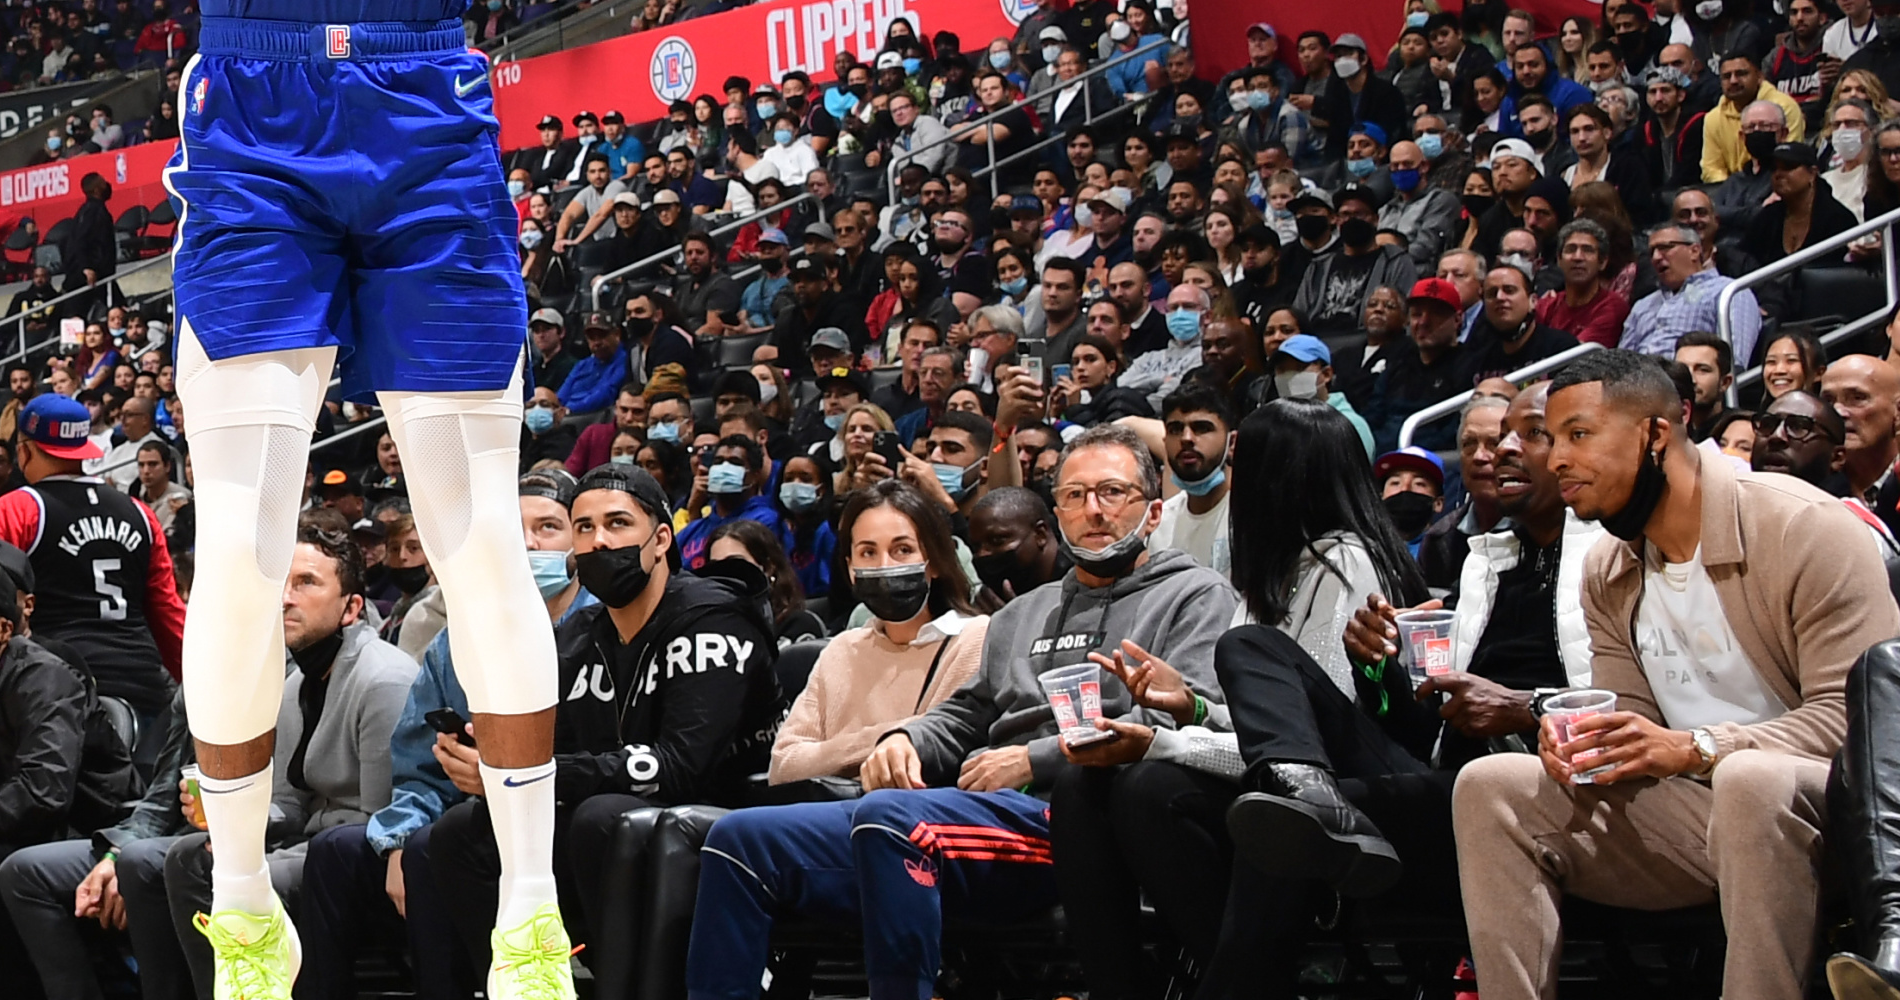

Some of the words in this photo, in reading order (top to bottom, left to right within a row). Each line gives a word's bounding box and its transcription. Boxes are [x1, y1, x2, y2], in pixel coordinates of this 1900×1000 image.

[496, 64, 520, 88] 110
[14, 164, 69, 204] CLIPPERS
[58, 515, 142, 557] KENNARD
[92, 558, 127, 621] 5
[1427, 651, 1448, 667] 20
[1083, 694, 1100, 710] 20
